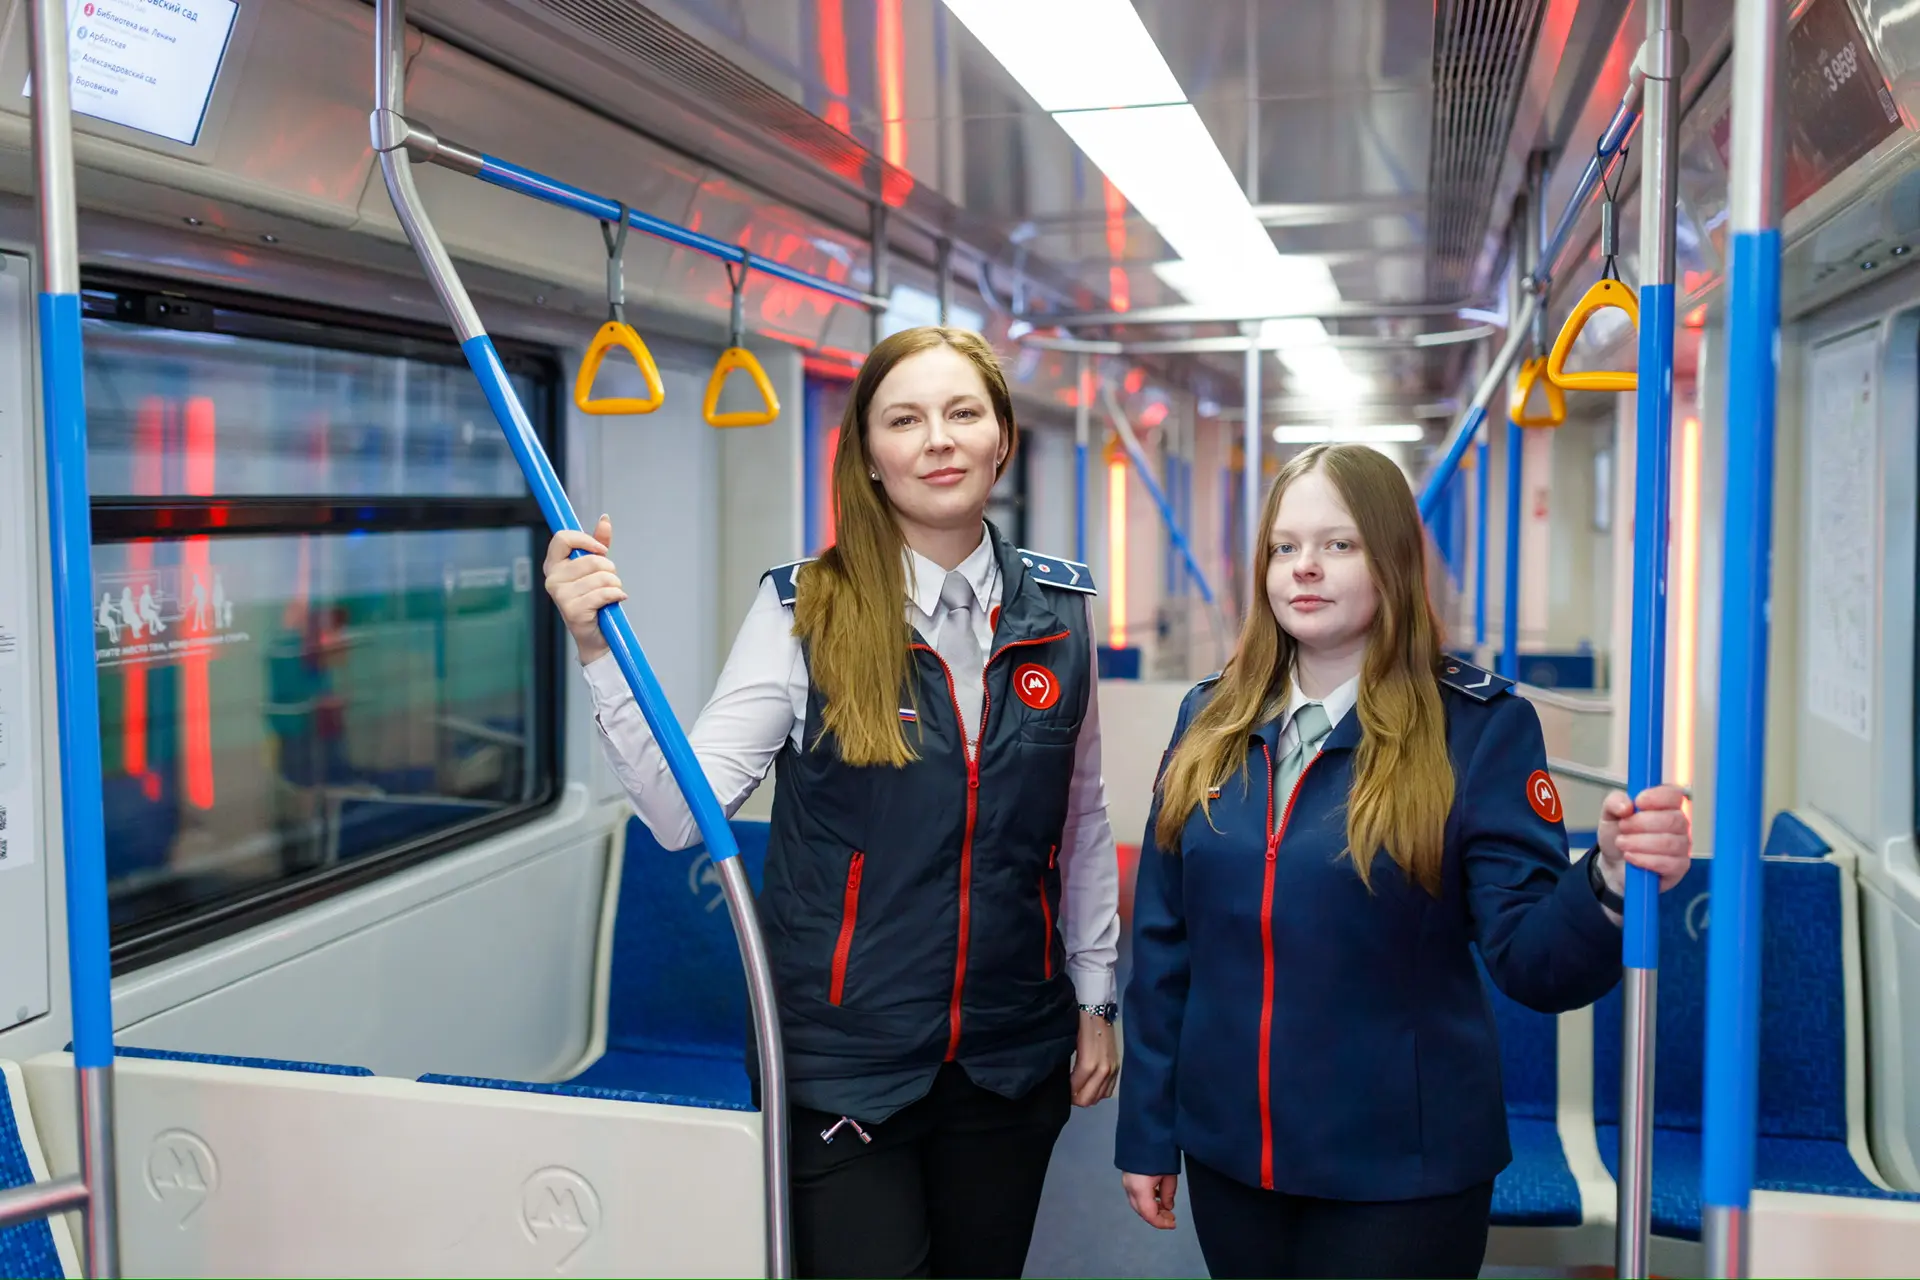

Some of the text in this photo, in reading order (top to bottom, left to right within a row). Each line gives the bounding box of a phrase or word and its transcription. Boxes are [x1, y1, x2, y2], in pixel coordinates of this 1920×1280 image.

[96, 8, 138, 30] Библиотека
[182, 8, 198, 21] сад
[89, 31, 127, 49] Арбатская
[82, 53, 144, 80] Александровский
[145, 75, 157, 85] сад
[76, 76, 119, 96] Боровицкая
